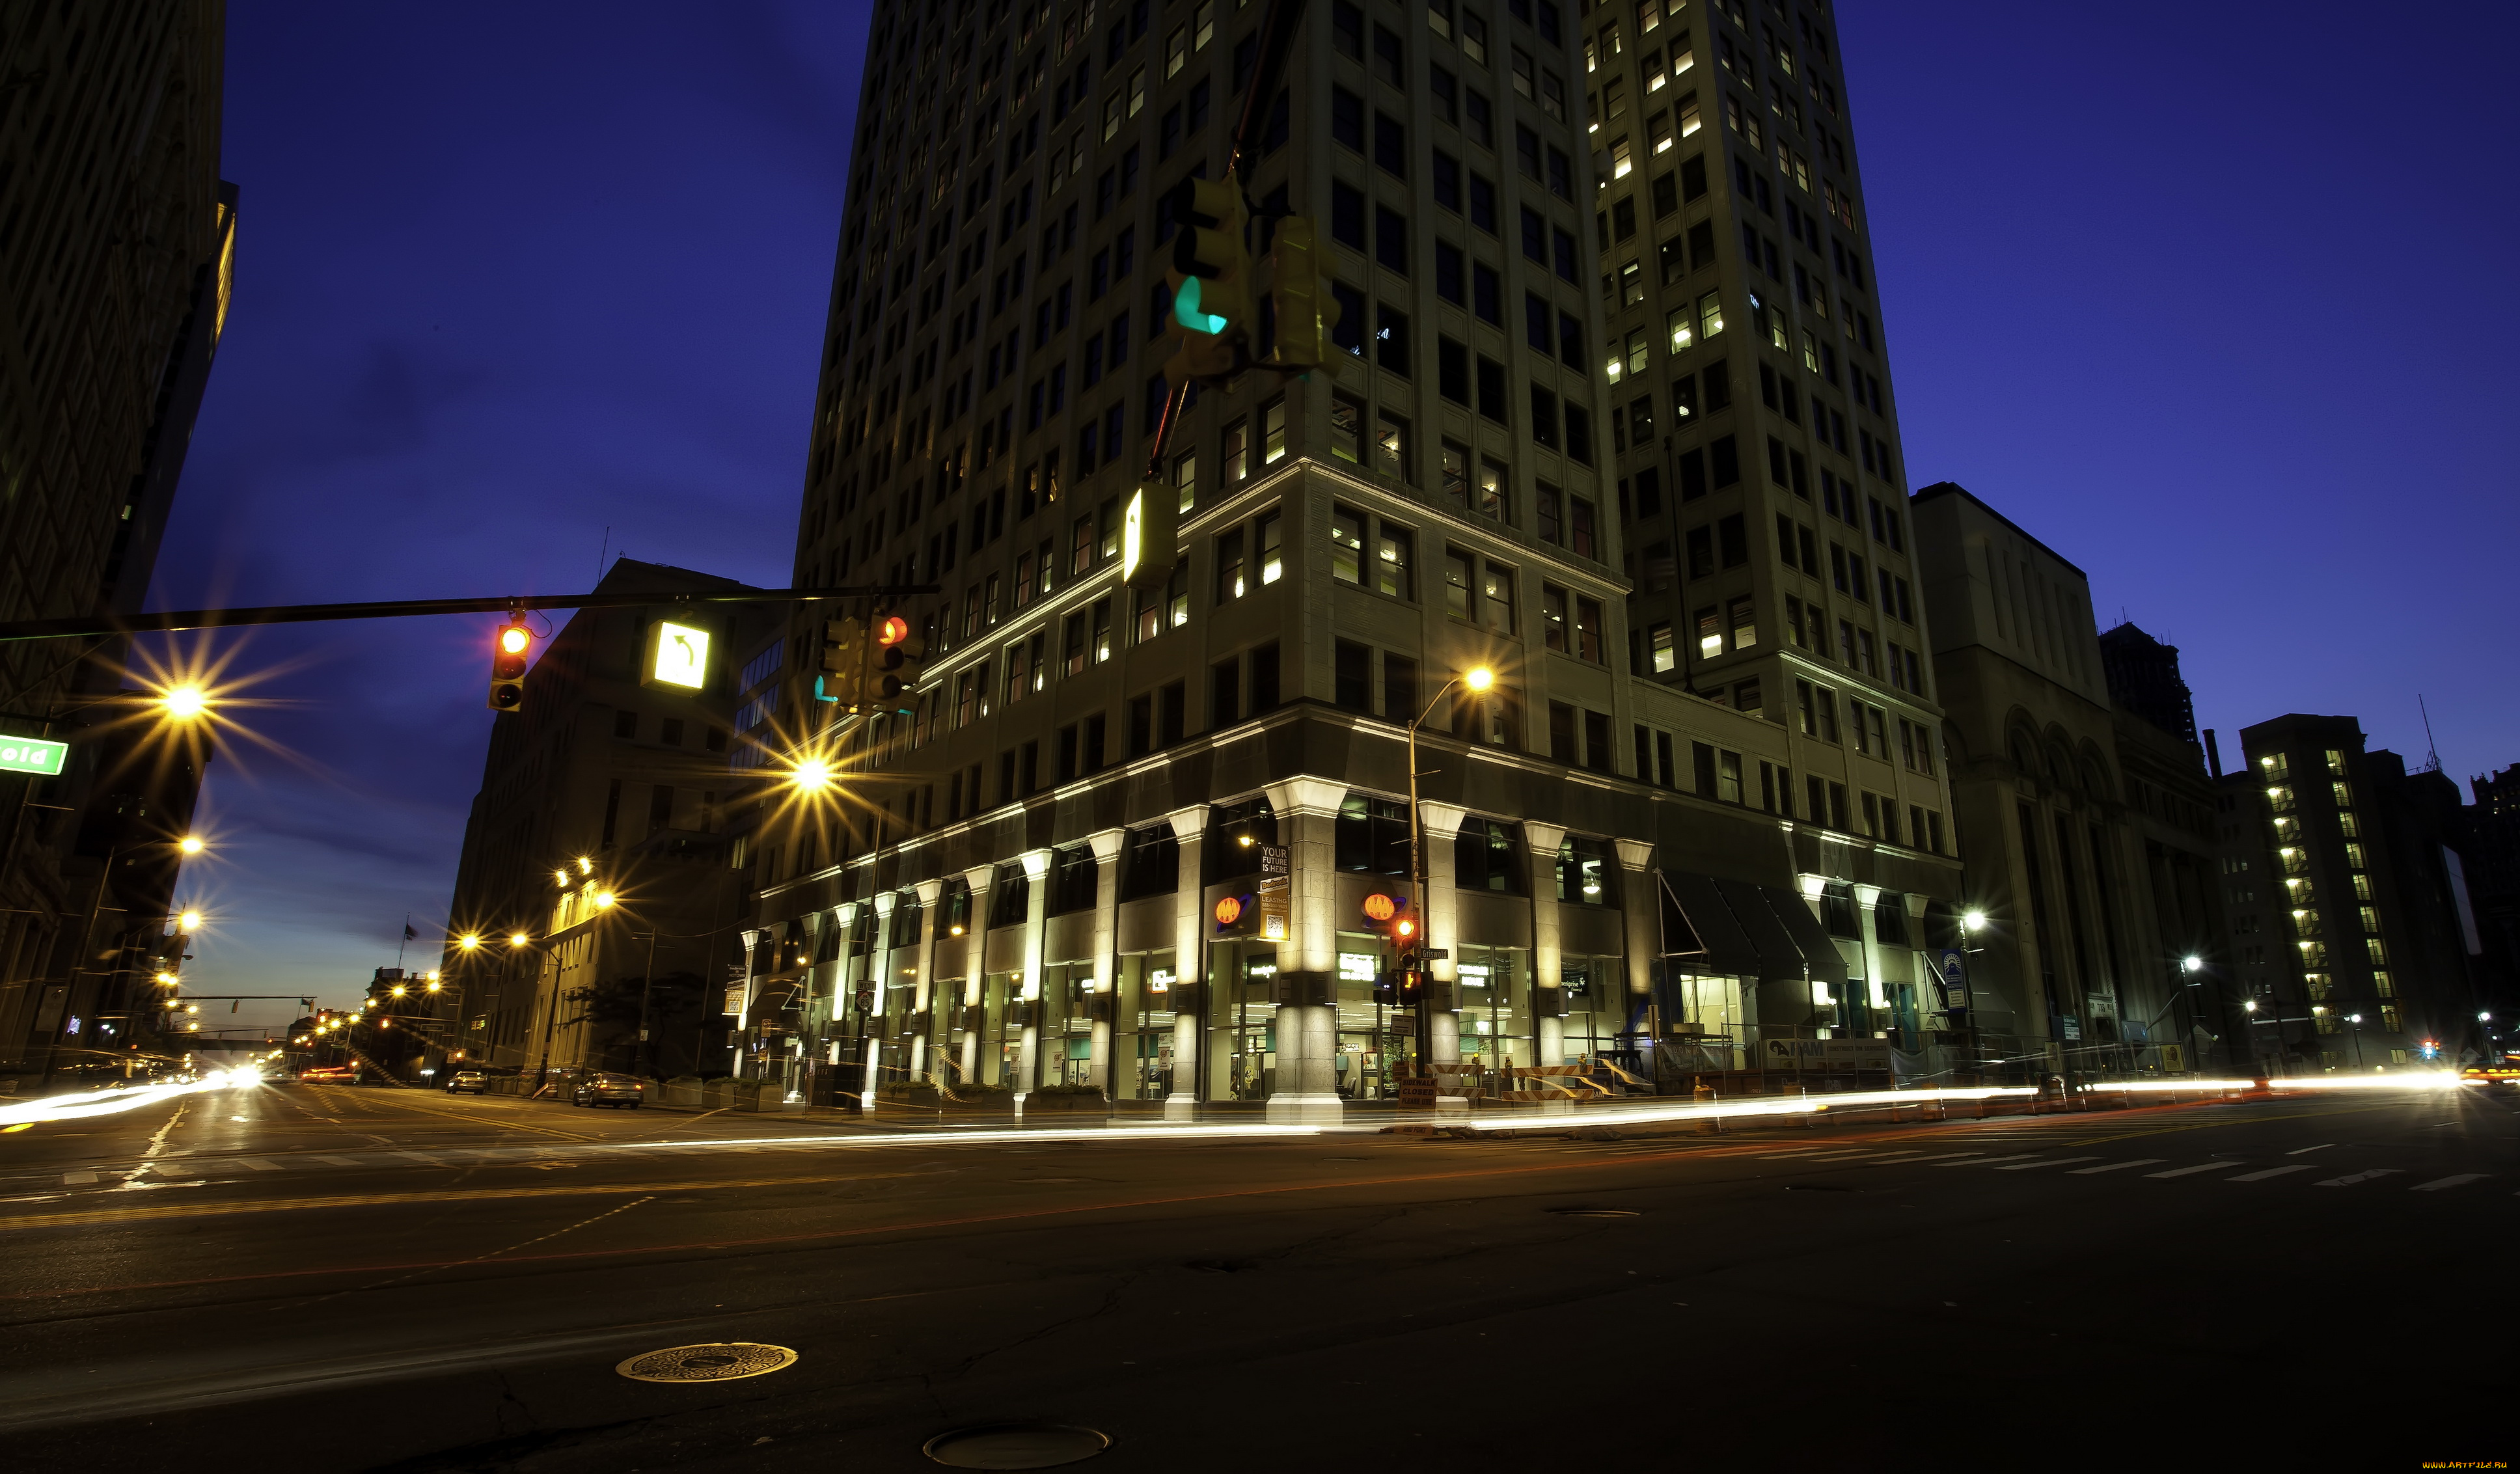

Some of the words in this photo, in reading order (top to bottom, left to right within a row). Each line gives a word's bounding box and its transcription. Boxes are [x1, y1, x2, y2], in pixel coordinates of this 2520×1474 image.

[0, 746, 48, 765] old
[1262, 846, 1287, 858] YOUR
[1263, 856, 1287, 866] FUTURE
[1263, 864, 1269, 872] IS
[1270, 865, 1287, 874] HERE
[1261, 878, 1288, 890] Bedrock
[1261, 895, 1287, 904] LEASING
[1423, 949, 1447, 959] Griswold
[860, 999, 870, 1007] 85
